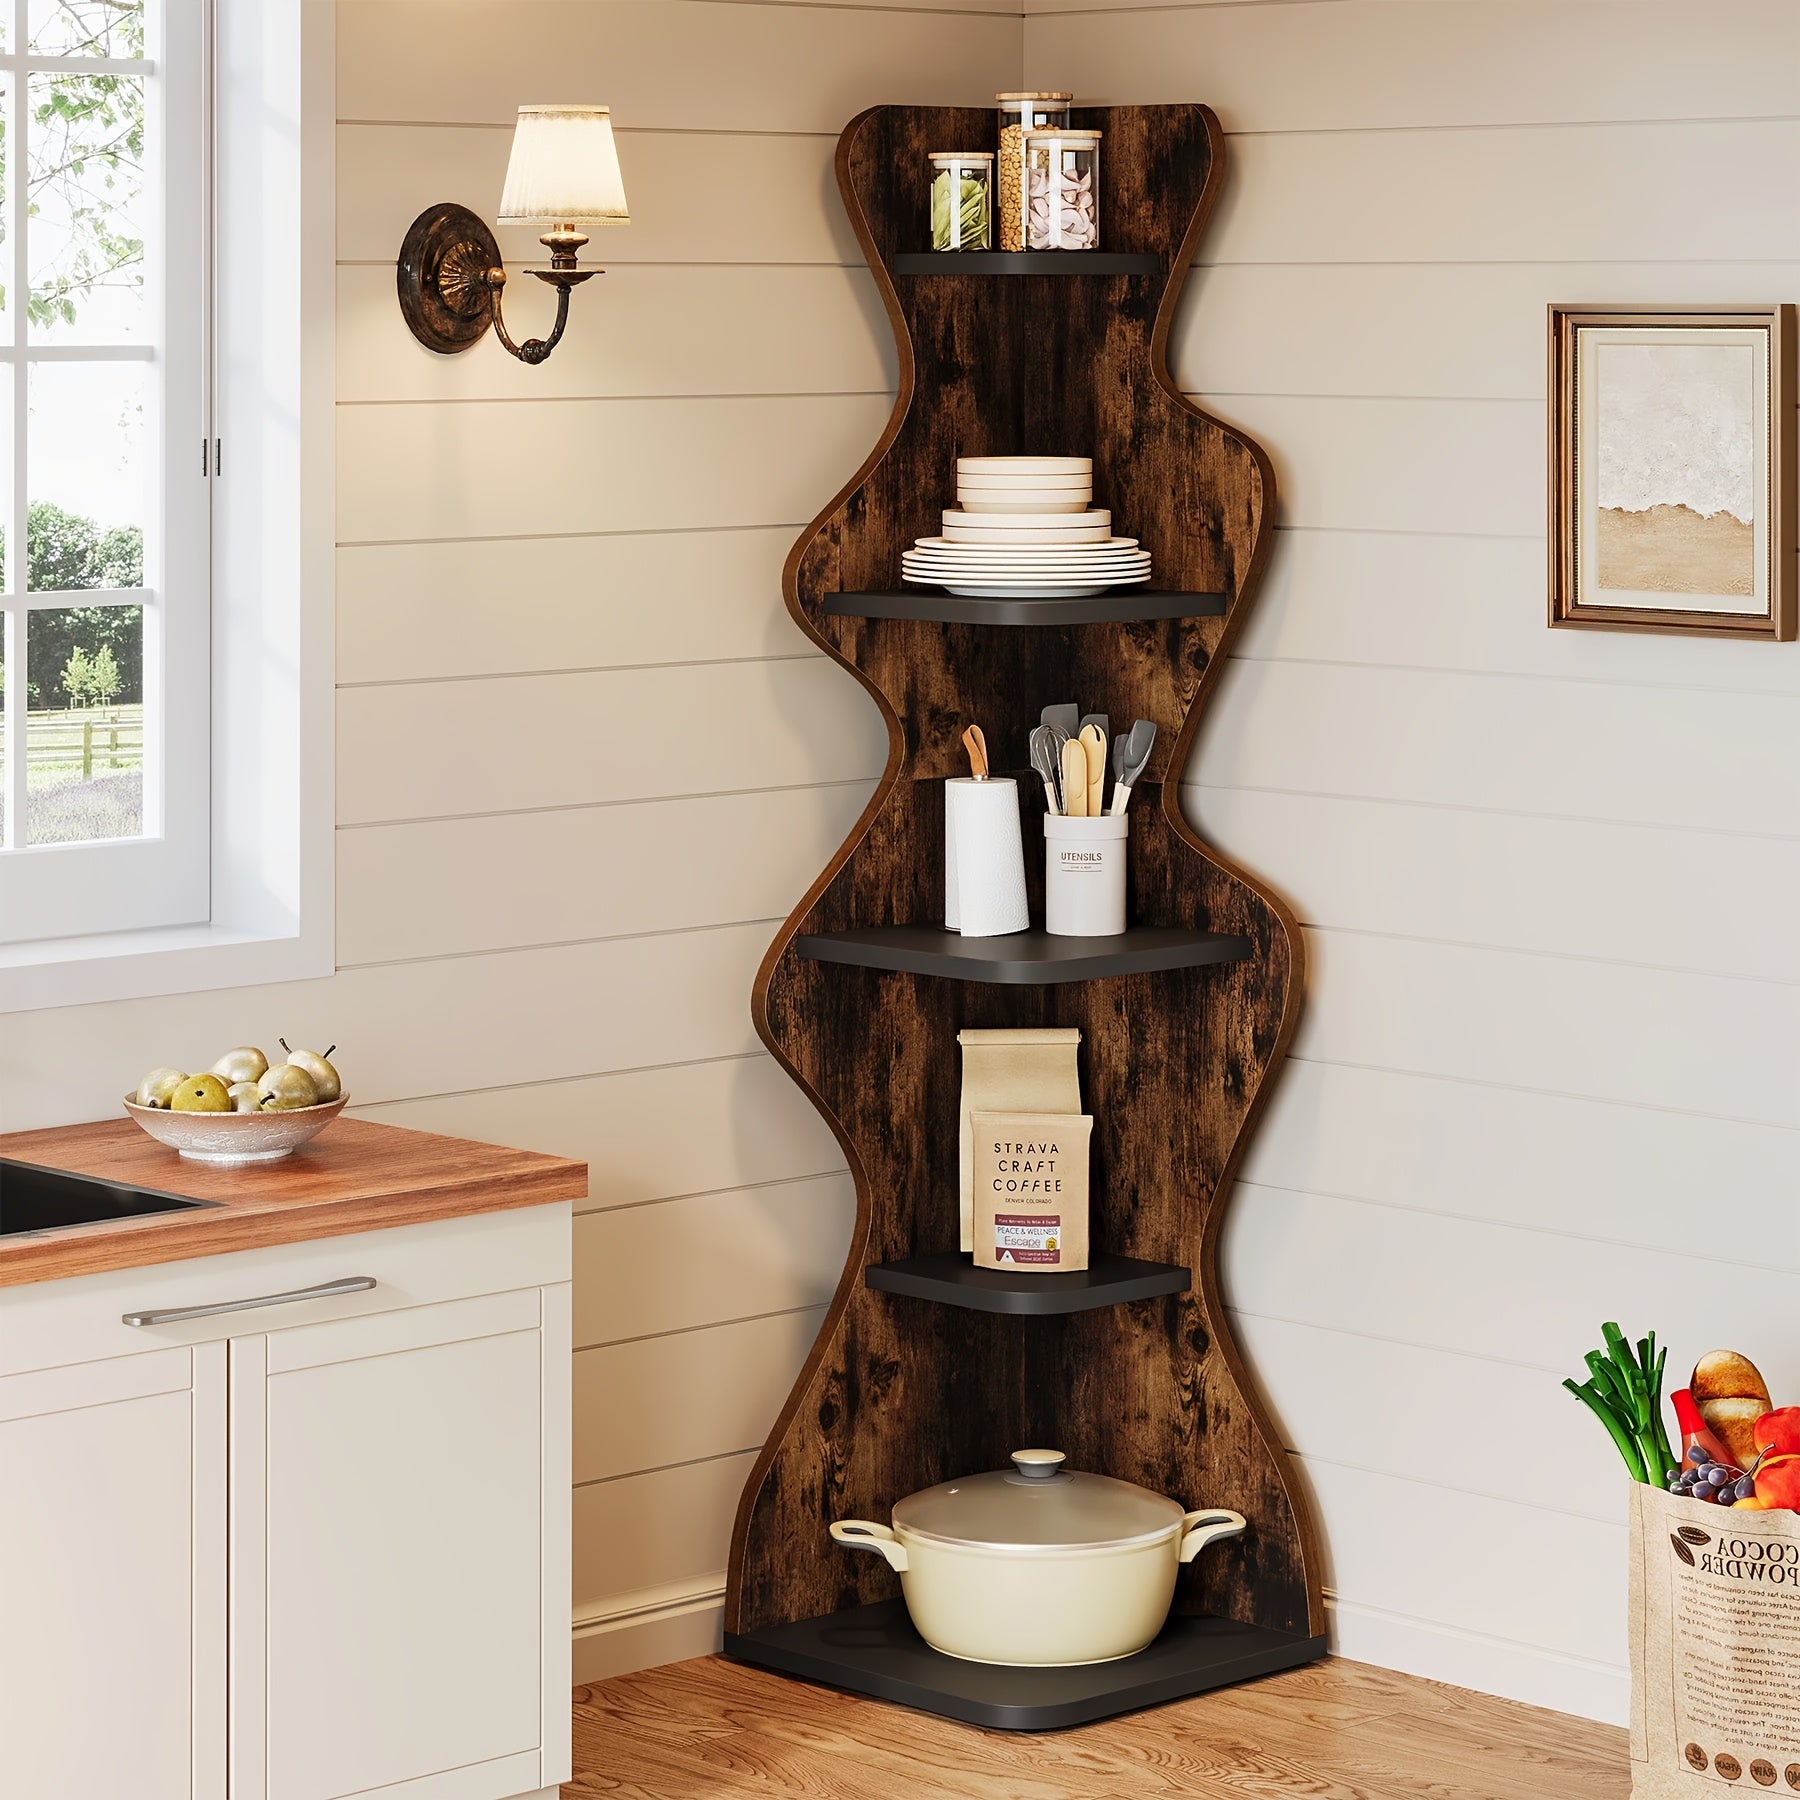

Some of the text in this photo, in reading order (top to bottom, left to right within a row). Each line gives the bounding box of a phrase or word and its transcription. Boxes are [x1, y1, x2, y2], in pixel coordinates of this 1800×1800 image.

[1061, 852, 1102, 861] UTENSILS
[998, 1160, 1055, 1173] CRAFT
[993, 1179, 1062, 1192] COFFEE
[1004, 1236, 1041, 1248] Escape
